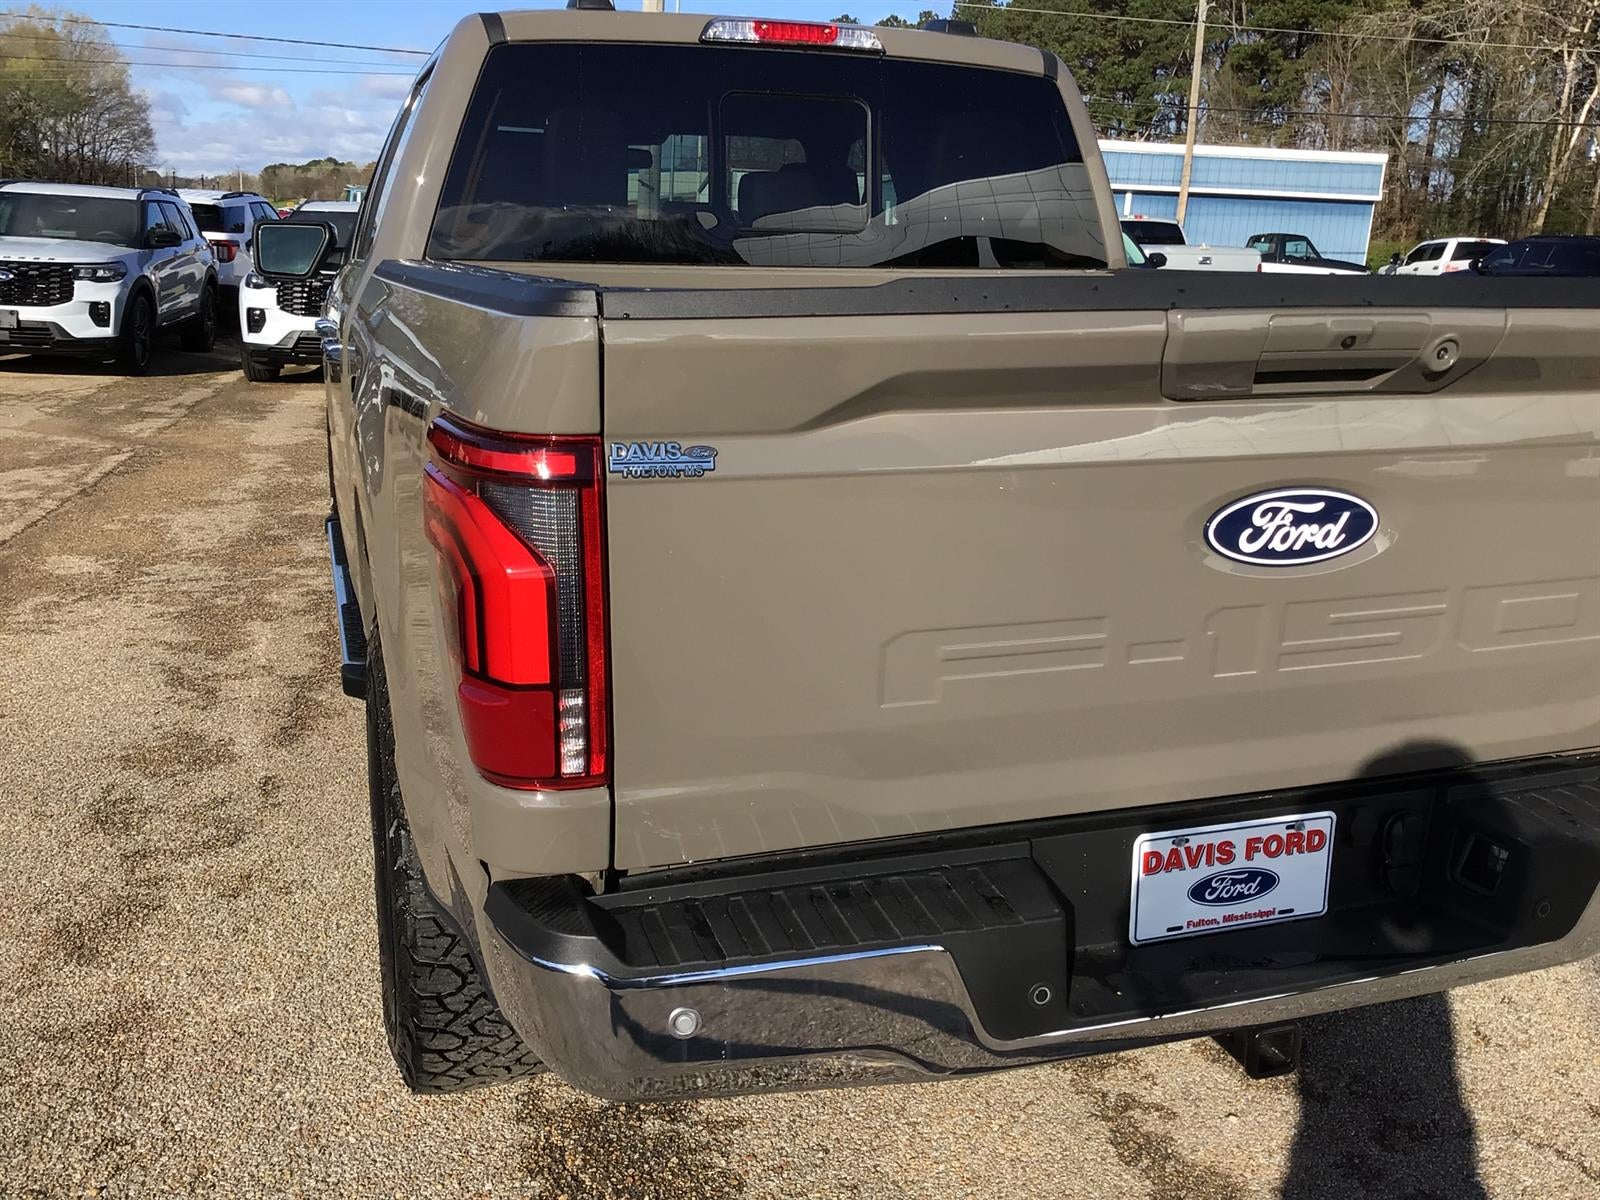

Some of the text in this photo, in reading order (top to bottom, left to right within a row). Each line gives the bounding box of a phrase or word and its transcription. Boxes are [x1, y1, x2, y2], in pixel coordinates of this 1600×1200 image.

[611, 443, 682, 461] DAVIS
[683, 465, 704, 477] MS
[1238, 501, 1350, 554] Ford
[877, 574, 1600, 709] F-150
[1142, 829, 1327, 876] DAVIS FORD
[1205, 873, 1262, 901] Ford
[1186, 907, 1276, 929] Fulton, Mississippi
